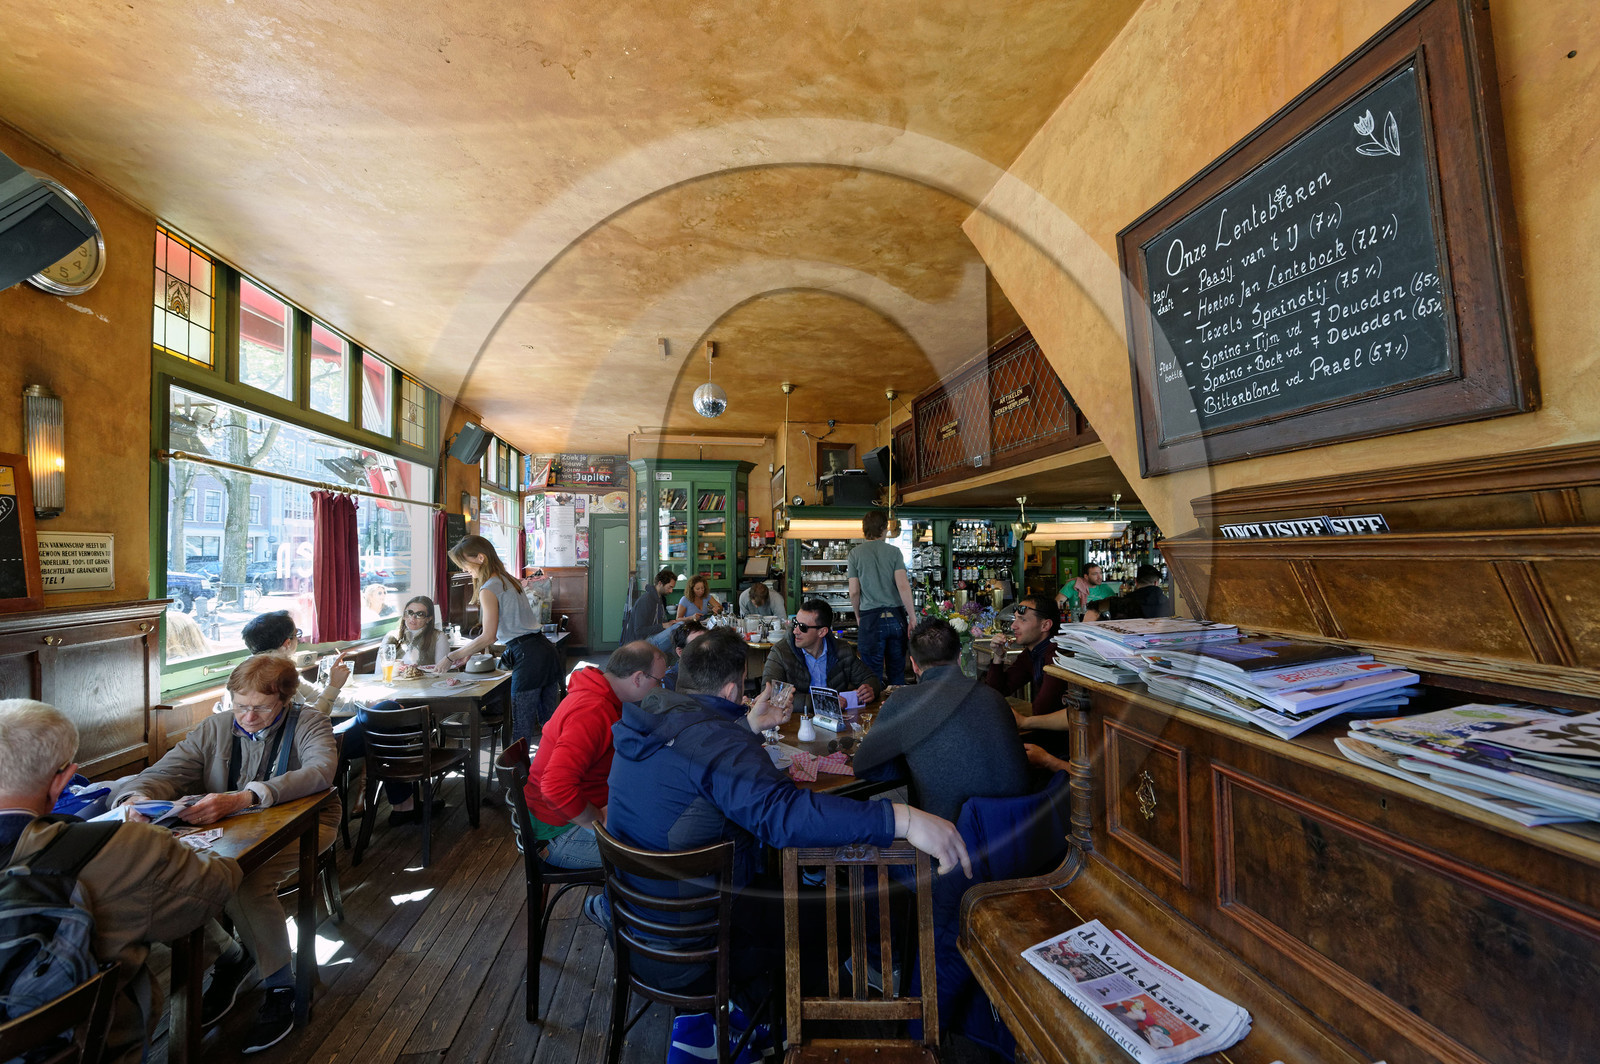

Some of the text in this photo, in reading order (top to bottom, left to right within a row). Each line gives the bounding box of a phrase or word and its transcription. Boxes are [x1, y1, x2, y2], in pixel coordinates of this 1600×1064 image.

[1166, 172, 1332, 277] Onze Lentebieren
[59, 267, 69, 279] 5
[73, 260, 82, 270] 4
[1198, 258, 1234, 291] Paasij
[1241, 247, 1266, 267] van
[1238, 280, 1261, 308] Jan
[1266, 238, 1347, 290] Lentebock
[1157, 298, 1175, 316] draft
[1196, 316, 1243, 344] Texels
[1251, 279, 1327, 329] Springtij
[1200, 343, 1241, 369] Spring
[1252, 331, 1280, 352] Tijm
[1286, 320, 1303, 338] vd
[1311, 311, 1321, 329] 7
[1327, 286, 1407, 323] Deugden
[1164, 369, 1183, 383] bottle
[1202, 366, 1243, 392] Spring
[1254, 353, 1284, 371] Bock
[1286, 343, 1303, 358] vd
[1310, 335, 1320, 349] 7
[1327, 308, 1407, 345] Deugden
[1203, 379, 1280, 415] Bitterblond
[1286, 371, 1303, 387] vd
[1309, 348, 1362, 381] Prael
[575, 472, 610, 483] Jupiler
[1067, 993, 1079, 1008] zet
[1088, 1010, 1105, 1030] aan
[1104, 1023, 1118, 1039] tot
[1117, 1035, 1142, 1058] actie
